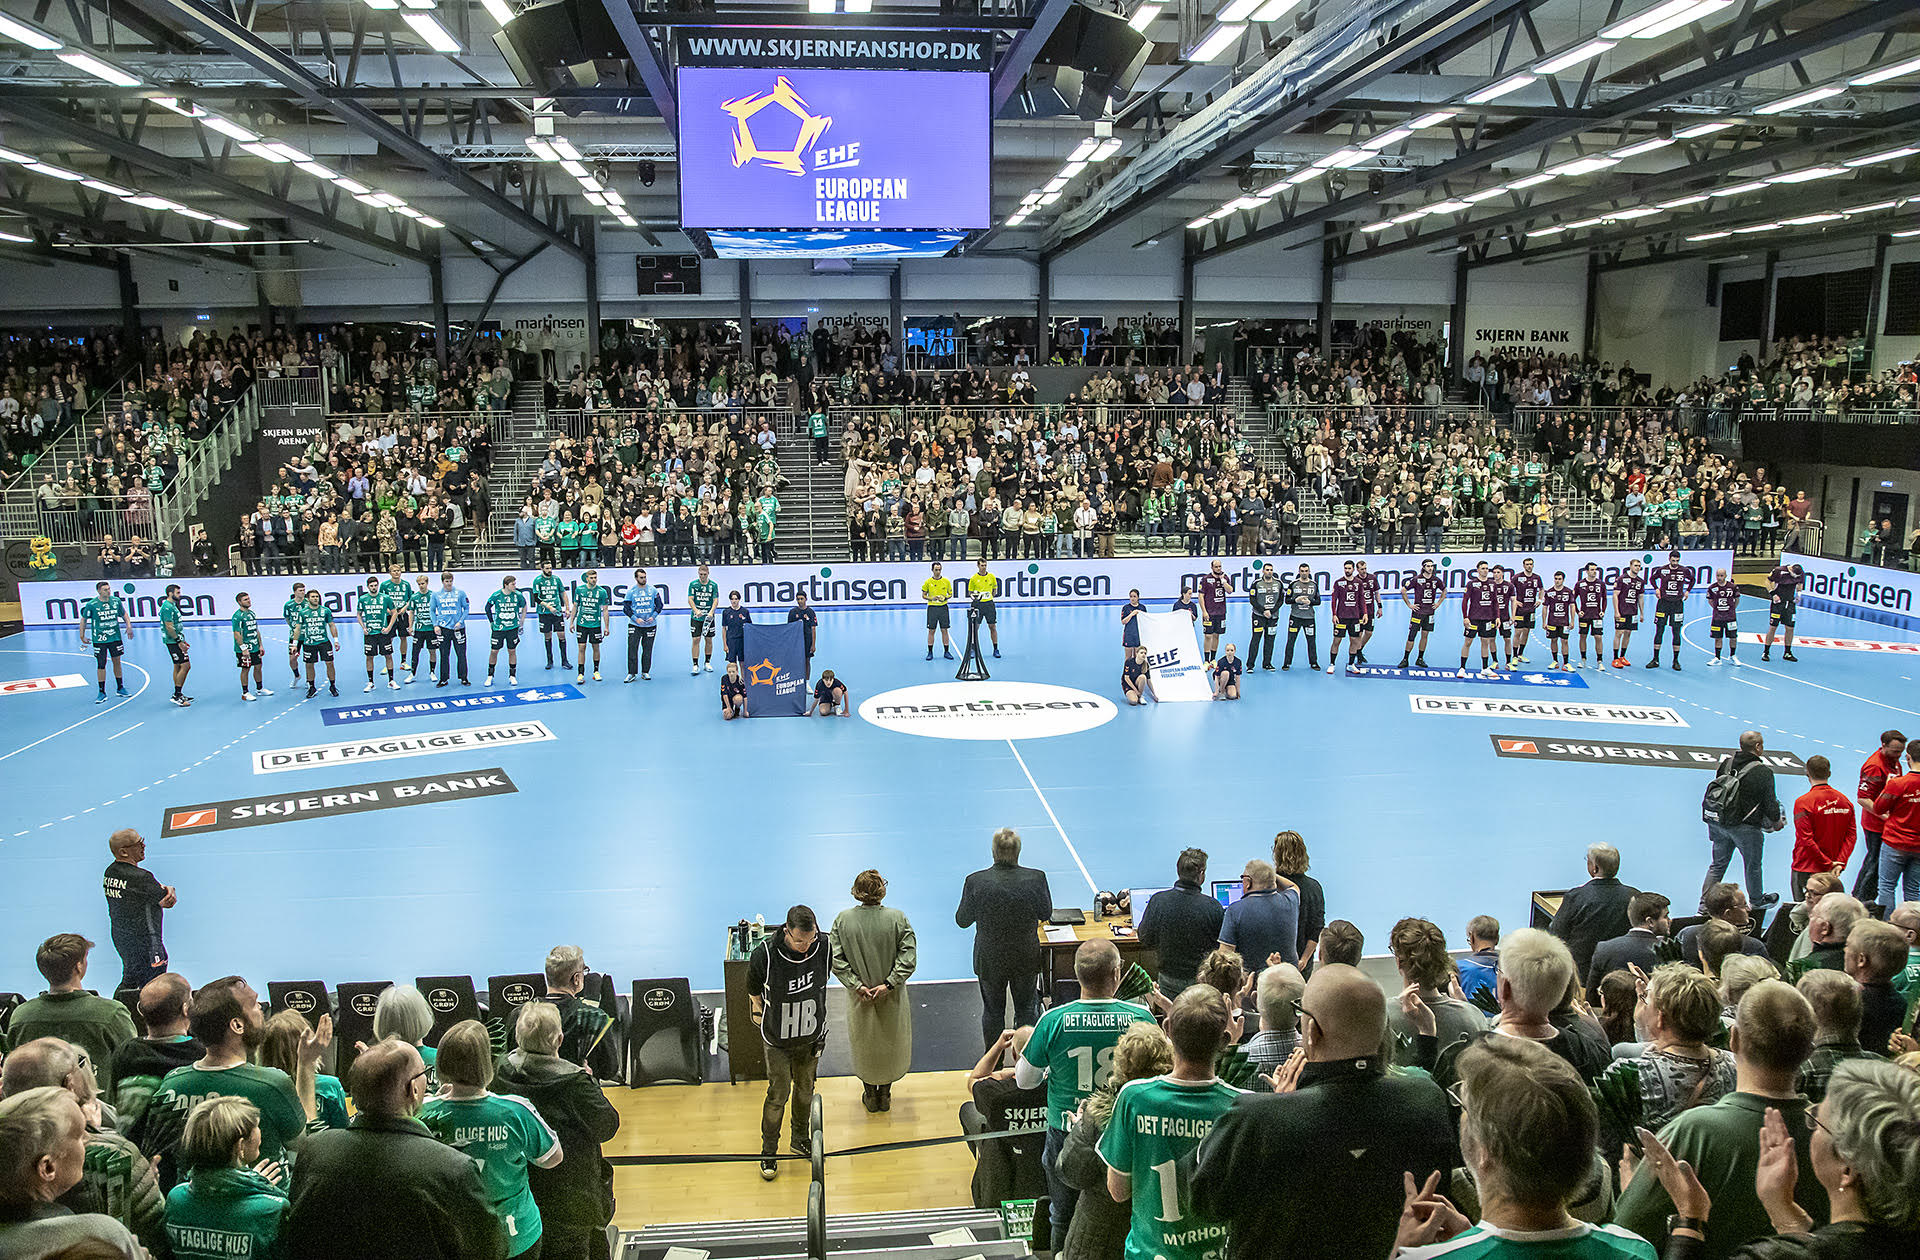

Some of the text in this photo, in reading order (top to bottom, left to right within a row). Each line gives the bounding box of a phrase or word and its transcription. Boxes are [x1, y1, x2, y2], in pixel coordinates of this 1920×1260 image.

[688, 38, 981, 61] WWW.SKJERNFANSHOP.DK
[815, 142, 860, 167] EHF
[816, 178, 907, 200] EUROPEAN
[816, 201, 880, 222] LEAGUE
[515, 314, 584, 329] martinsen
[1475, 329, 1569, 343] SKJERN BANK
[1499, 346, 1545, 358] ARENA
[262, 428, 322, 438] SKJERN BANK
[278, 437, 308, 445] ARENA
[744, 567, 907, 602] martinsen
[1147, 648, 1178, 666] EHF
[1359, 667, 1402, 676] FLYT
[776, 679, 804, 689] EUROPEAN
[776, 686, 796, 695] LEAGUE
[338, 694, 506, 720] FLYT MOD VEST
[876, 700, 1100, 714] martinsen
[1425, 700, 1665, 720] DET FAGLIGE HUS
[272, 726, 539, 766] DET FAGLIGE HUS
[1547, 743, 1679, 762] SKJERN
[230, 774, 507, 820] SKJERN BANK
[105, 888, 122, 898] ANK
[788, 971, 814, 990] EHF
[780, 999, 817, 1040] HB
[1065, 1014, 1080, 1026] DET
[1082, 1014, 1115, 1026] FAGLIGE
[488, 1125, 509, 1142] HUS
[1137, 1114, 1158, 1136] DET
[180, 1229, 223, 1252] FAGLIGE
[225, 1235, 249, 1254] HUS
